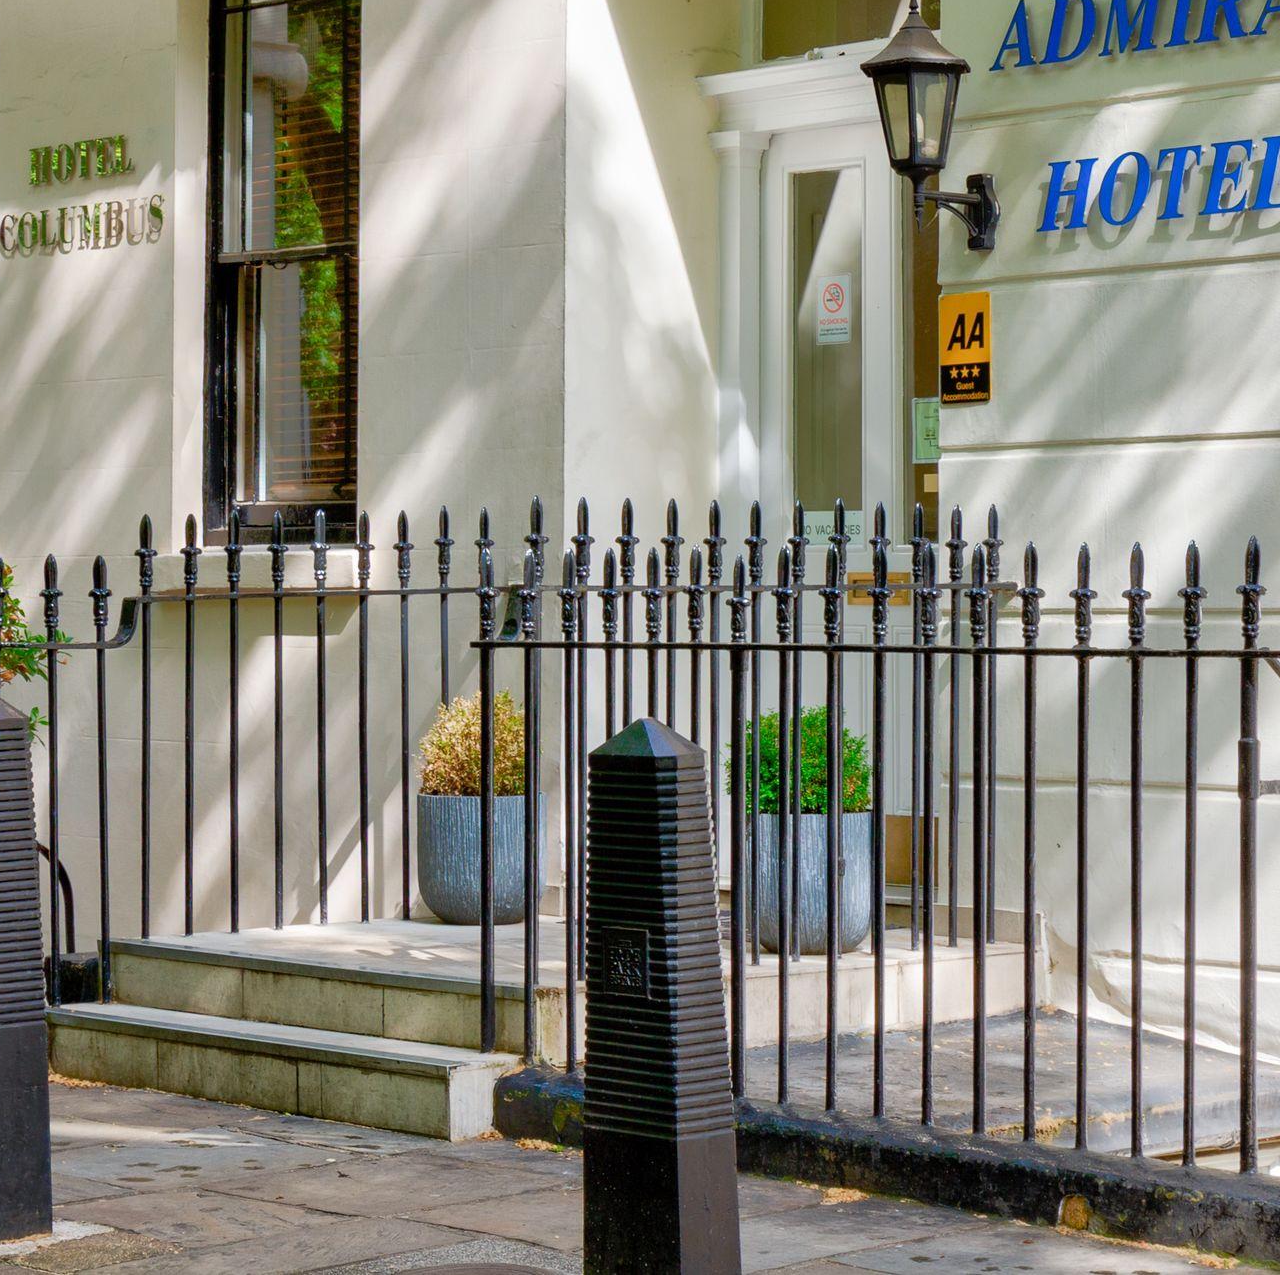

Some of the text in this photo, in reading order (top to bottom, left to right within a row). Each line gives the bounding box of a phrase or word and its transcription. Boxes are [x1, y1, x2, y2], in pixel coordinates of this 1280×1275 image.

[29, 134, 136, 186] HOTEL
[0, 193, 166, 252] COLUMBUS
[947, 311, 985, 352] AA
[942, 390, 990, 402] Accommodation
[955, 381, 975, 391] Guest
[803, 524, 861, 535] O VACACIES
